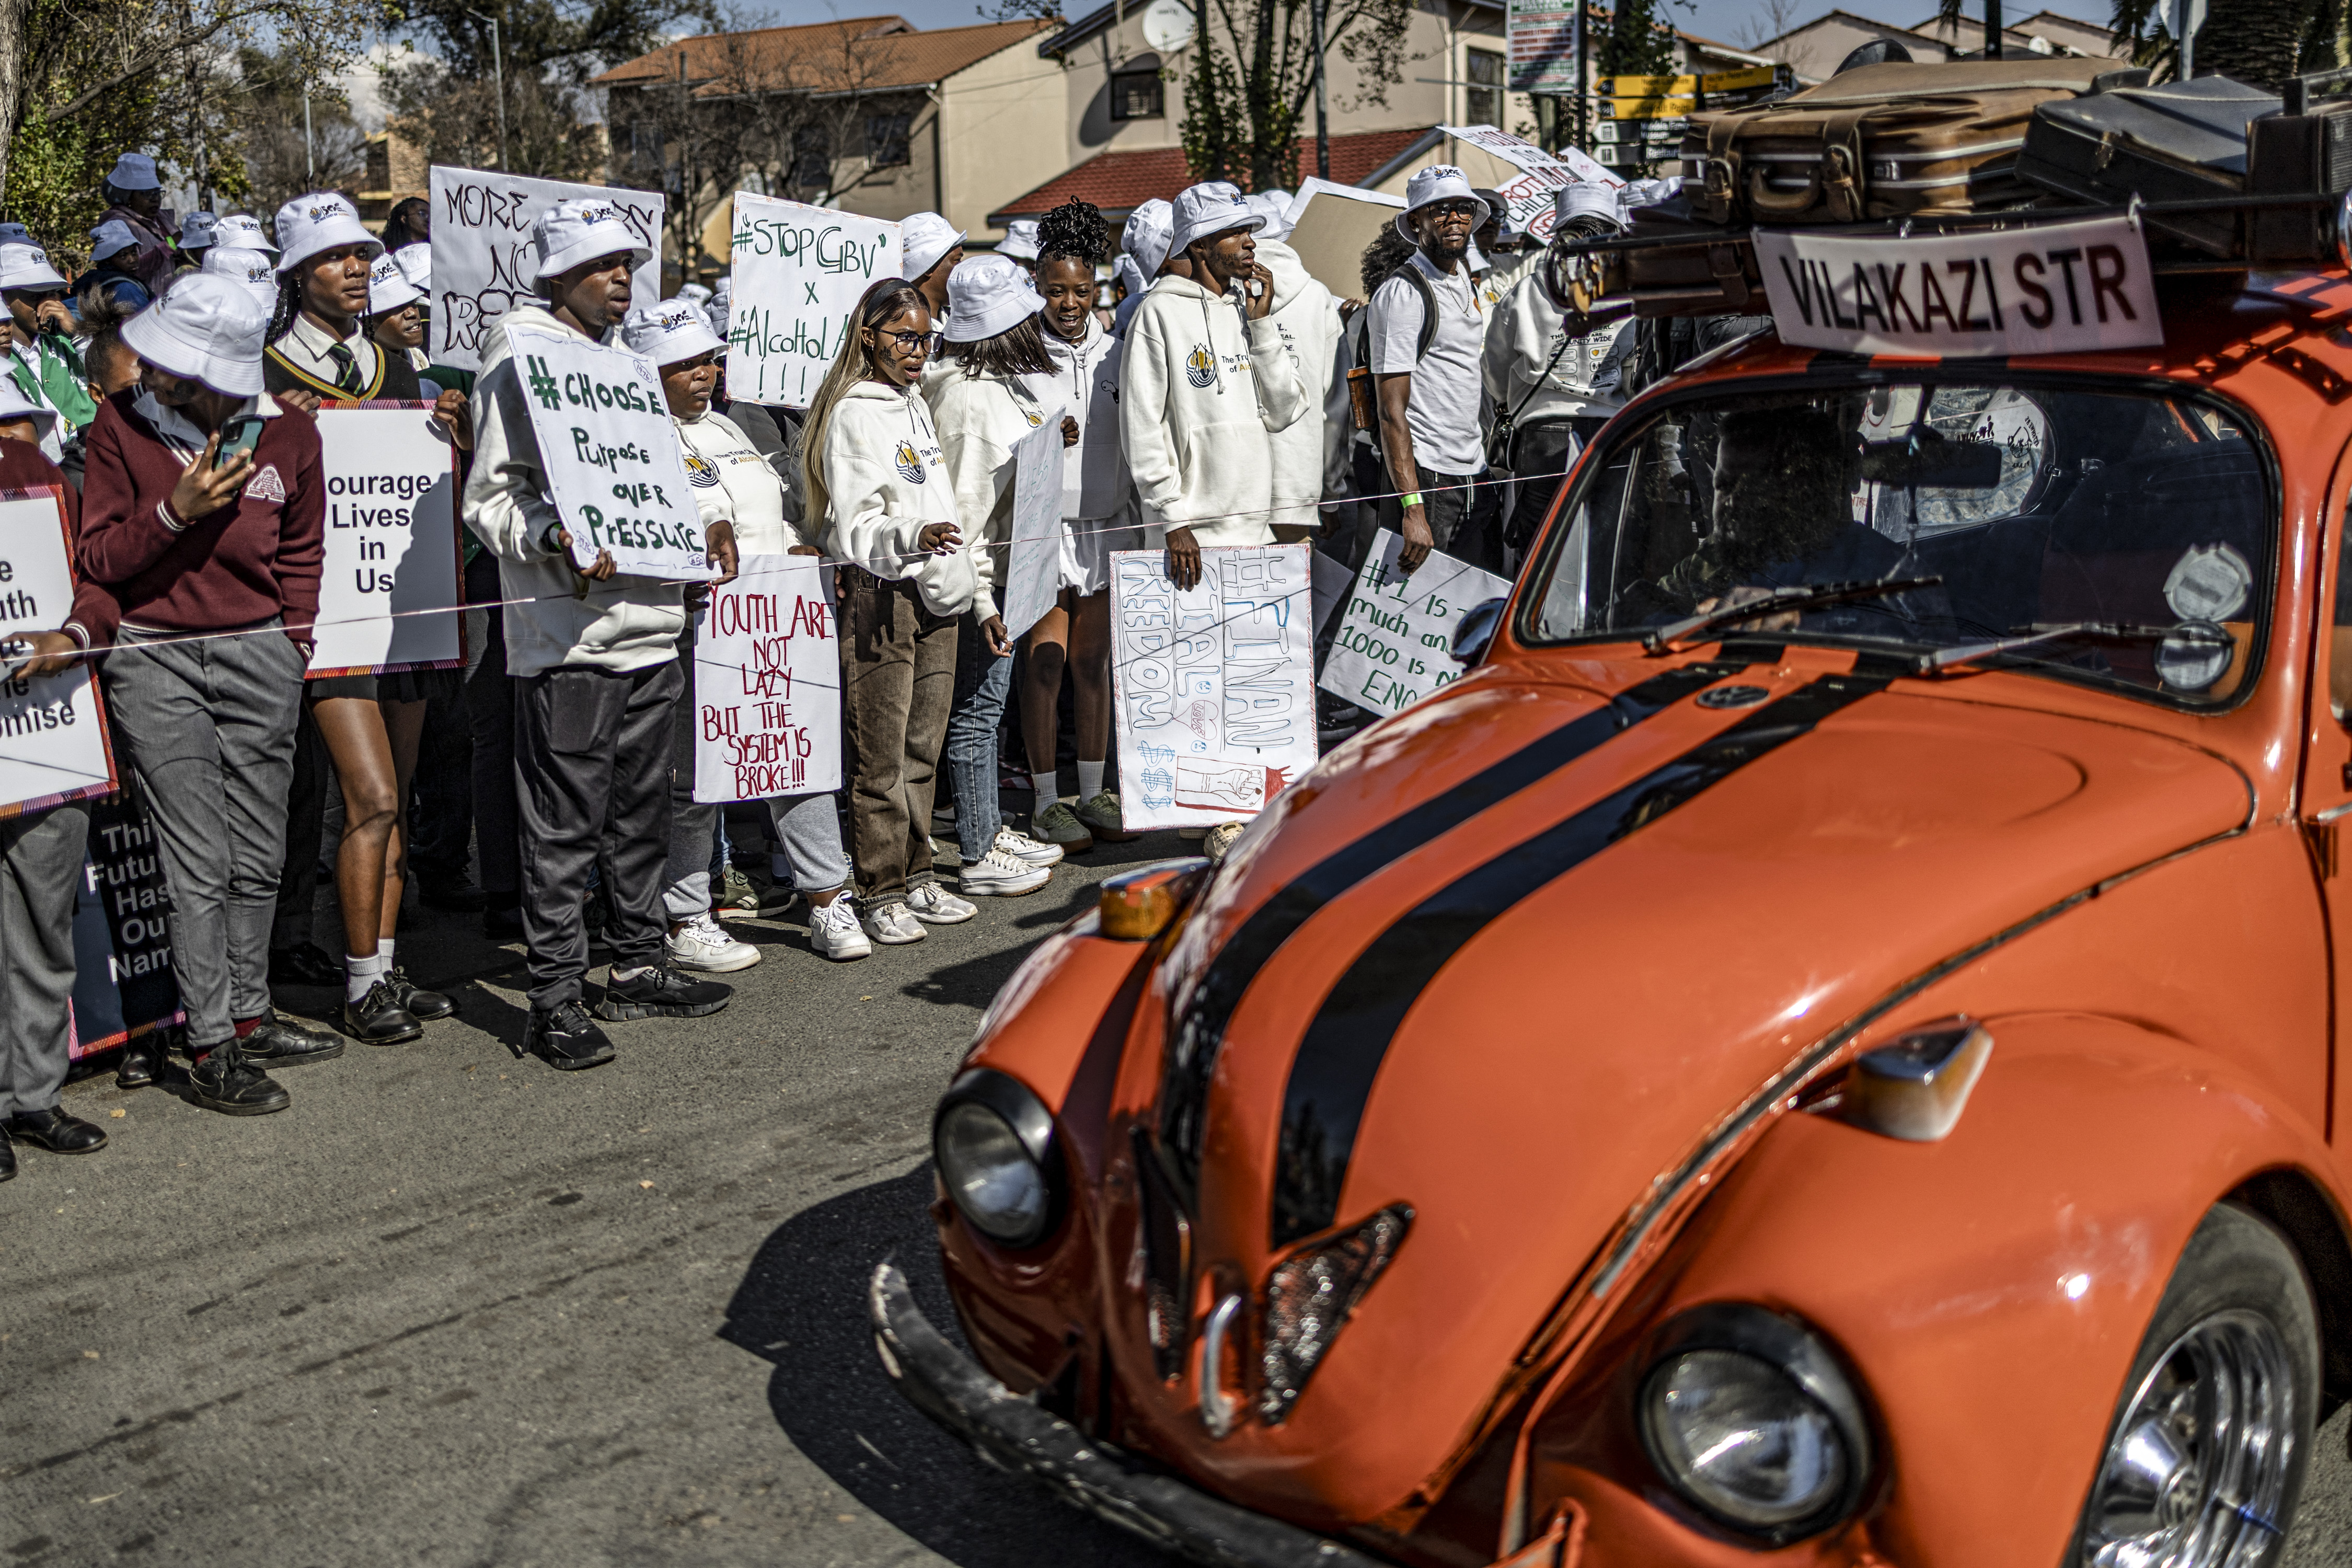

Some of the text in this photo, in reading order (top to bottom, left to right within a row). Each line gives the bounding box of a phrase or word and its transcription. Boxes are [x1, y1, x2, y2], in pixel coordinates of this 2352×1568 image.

[444, 184, 531, 232] MORE
[1779, 243, 2137, 333] VILAKAZI STR
[930, 446, 941, 455] Tru
[930, 458, 937, 466] of
[328, 474, 432, 500] ourage
[332, 503, 411, 529] Lives
[360, 536, 386, 560] in
[355, 568, 395, 594] Us
[707, 582, 835, 640] YOUTH ARE
[1425, 594, 1448, 618] IS
[1348, 597, 1450, 654] much an
[753, 636, 793, 670] NOT
[1334, 625, 1400, 665] 1000
[742, 663, 792, 700] LAZY
[701, 701, 795, 742] BUT THE
[721, 727, 812, 767] SYSTEM IS
[101, 818, 152, 852] Thi
[86, 852, 157, 895] Futu
[122, 914, 170, 945] Ou
[108, 945, 171, 985] Nam
